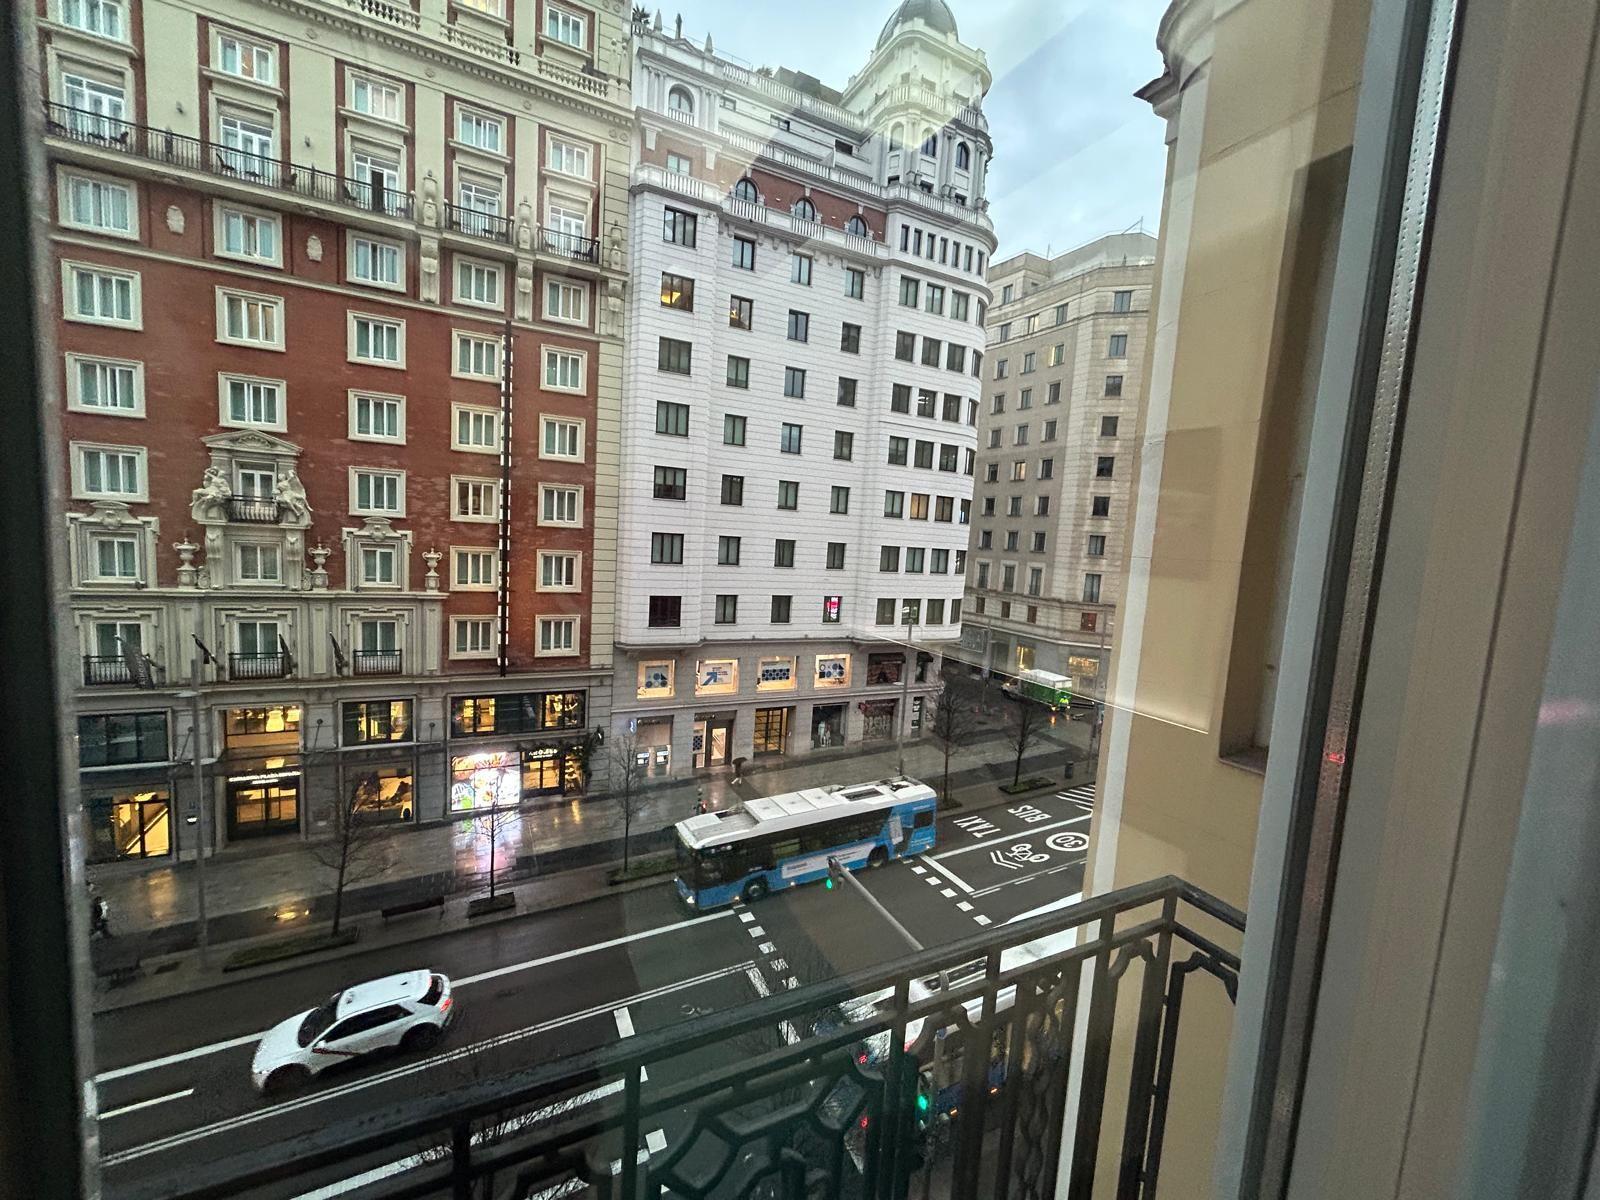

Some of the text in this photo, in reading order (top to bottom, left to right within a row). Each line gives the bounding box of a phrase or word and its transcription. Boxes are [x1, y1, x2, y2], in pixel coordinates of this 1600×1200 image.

[1007, 804, 1052, 823] BUS
[952, 815, 1001, 838] TAXI
[1055, 835, 1084, 848] 30
